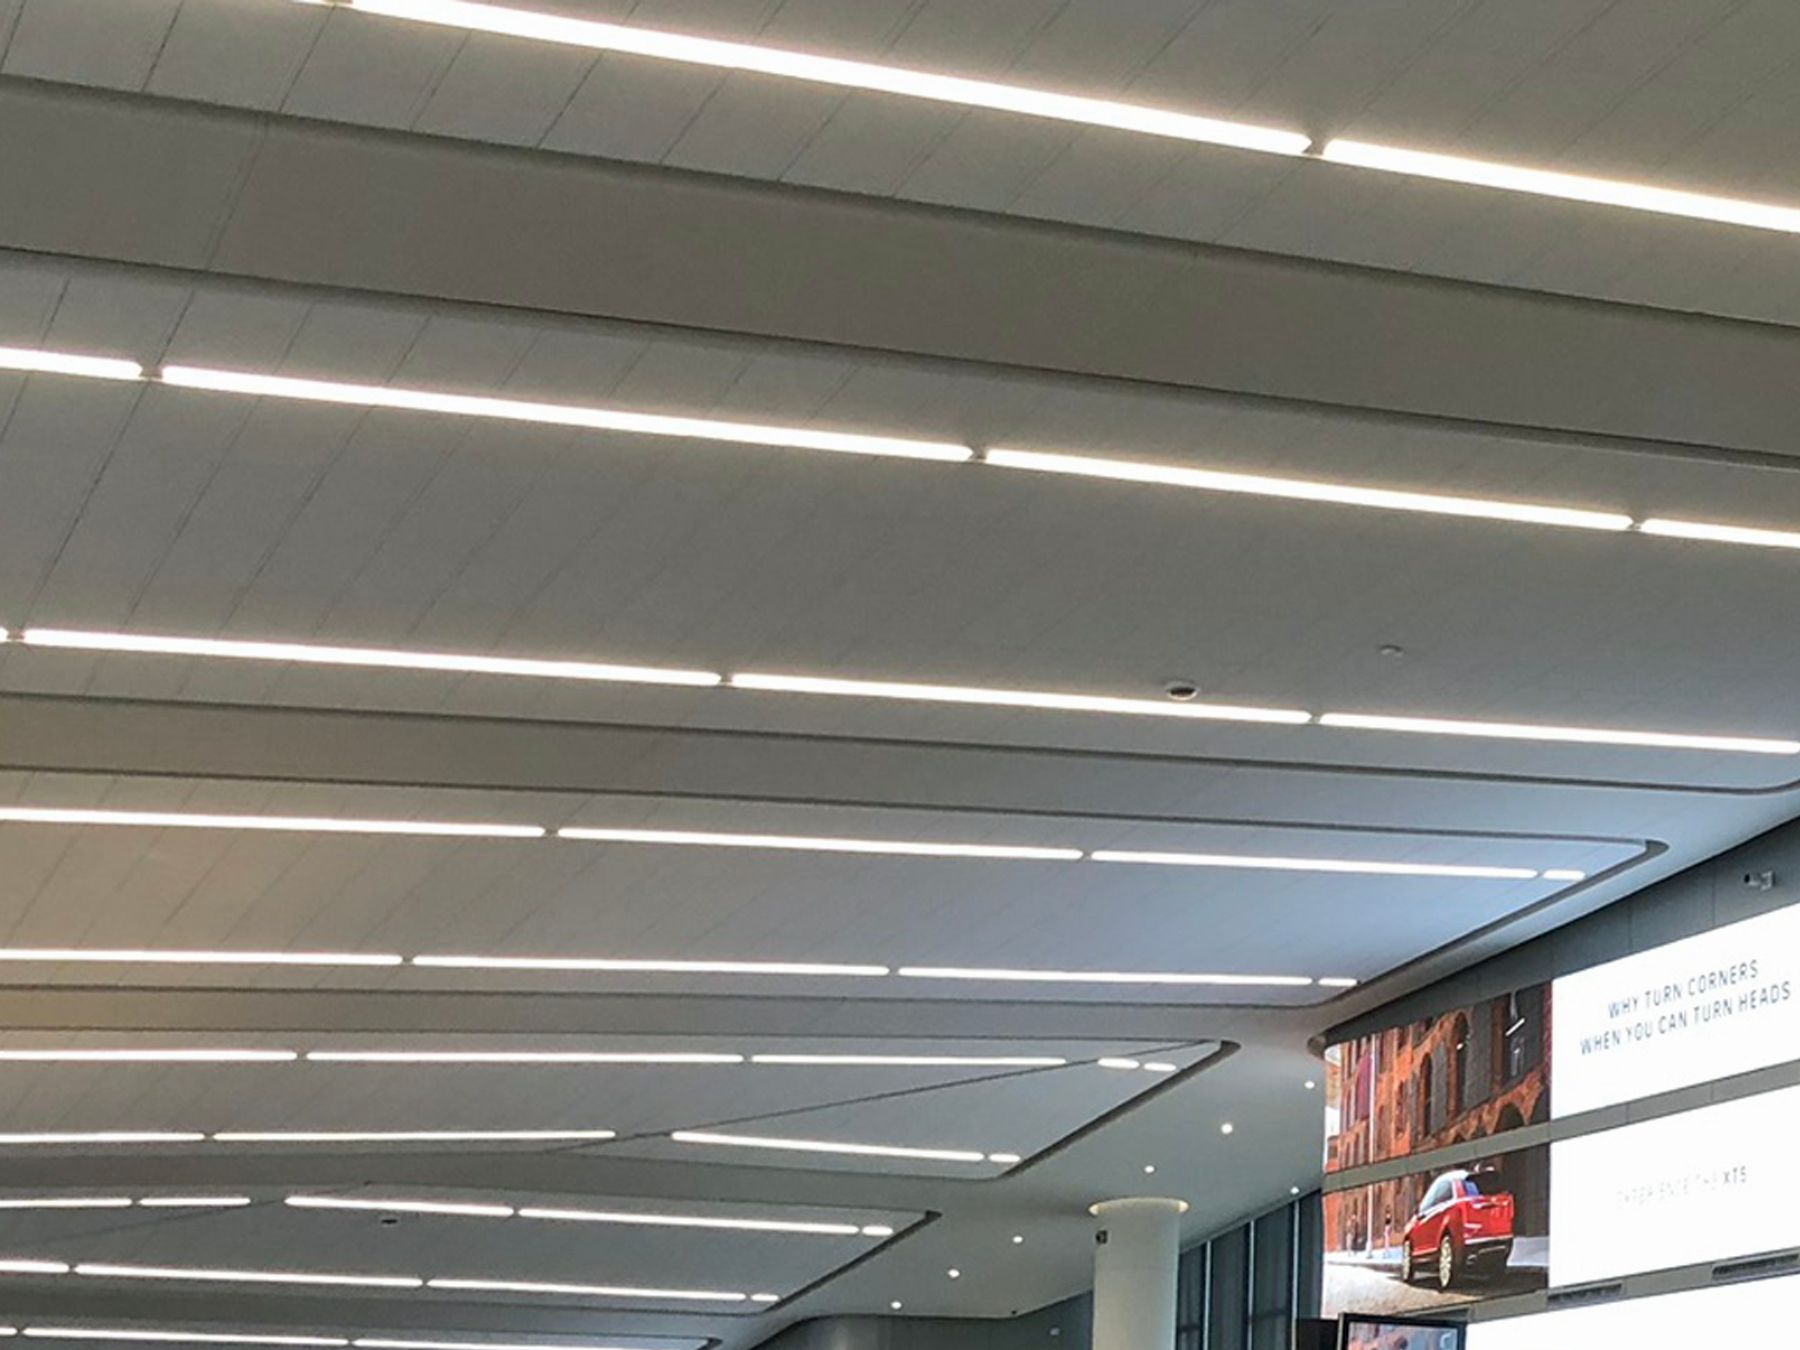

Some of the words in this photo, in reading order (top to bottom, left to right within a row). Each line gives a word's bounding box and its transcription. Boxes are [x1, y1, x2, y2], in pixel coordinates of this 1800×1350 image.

[1580, 1031, 1620, 1055] WHEN
[1626, 1022, 1653, 1043] YOU
[1658, 1011, 1687, 1034] CAN
[1693, 999, 1733, 1023] TURN
[1738, 981, 1791, 1013] HEADS
[1608, 998, 1639, 1018] WHY
[1645, 985, 1682, 1008] TURN
[1688, 960, 1758, 996] CORNERS
